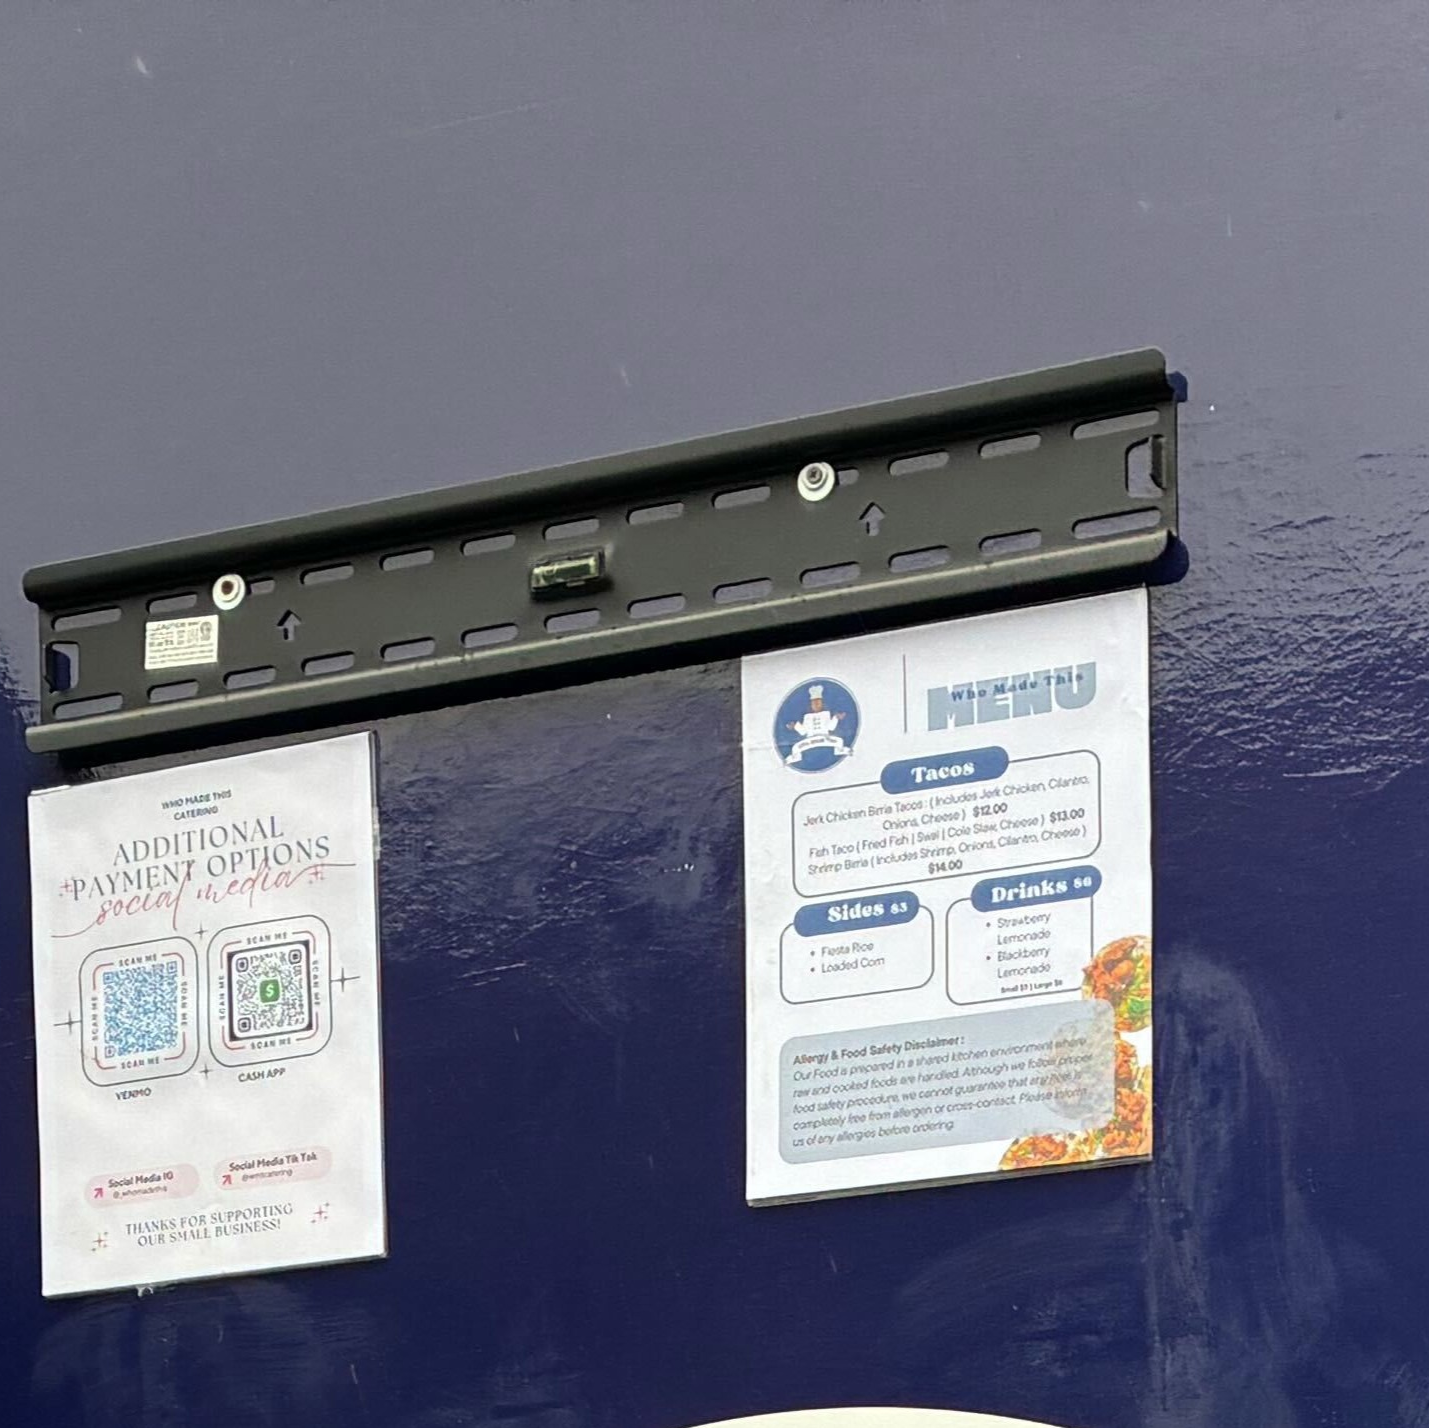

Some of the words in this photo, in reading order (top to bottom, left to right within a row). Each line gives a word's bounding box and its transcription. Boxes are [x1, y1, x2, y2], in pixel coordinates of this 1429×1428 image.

[951, 688, 986, 702] Who
[993, 680, 1038, 695] Made
[1044, 672, 1084, 686] This
[928, 661, 1096, 732] MENU
[911, 762, 975, 783] Tacos
[173, 805, 218, 820] CATERING
[803, 816, 824, 827] Jerk
[826, 810, 867, 823] Chicken
[895, 800, 923, 811] Tacos
[979, 787, 1000, 799] Jerk
[921, 812, 960, 825] Cheese
[973, 803, 1008, 818] $12.00
[113, 816, 284, 866] ADDITIONAL
[809, 846, 829, 858] Fish
[831, 844, 855, 855] Taco
[889, 835, 909, 847] Fish
[948, 826, 971, 838] Cole
[999, 817, 1039, 830] Cheese
[1049, 808, 1085, 823] $13.00
[808, 862, 843, 875] Shrimp
[1041, 828, 1080, 841] Cheese
[71, 859, 196, 900] PAYMENT
[207, 836, 329, 877] OPTIONS
[928, 859, 962, 875] $14.00
[83, 859, 196, 932] social
[197, 856, 306, 907] media
[991, 879, 1068, 903] Drinks
[827, 902, 884, 922] Sides
[997, 912, 1051, 928] Strawberry
[246, 934, 271, 945] SCAN
[275, 931, 288, 940] ME
[997, 928, 1051, 945] Lemonade
[821, 946, 849, 957] Fiesta
[852, 942, 874, 953] Rice
[997, 947, 1051, 962] Blackberry
[119, 956, 142, 967] SCAN
[145, 953, 157, 962] ME
[821, 960, 858, 973] Loaded
[860, 956, 885, 969] Corn
[997, 962, 1051, 979] Lemonade
[219, 976, 225, 990] ME
[91, 996, 98, 1011] ME
[314, 992, 321, 1006] ME
[91, 1013, 99, 1041] SCAN
[181, 1013, 188, 1026] ME
[250, 1039, 275, 1050] SCAN
[279, 1037, 292, 1046] ME
[793, 1052, 828, 1066] Allergy
[841, 1047, 867, 1059] Food
[870, 1042, 902, 1056] Safety
[793, 1071, 812, 1082] Our
[813, 1067, 839, 1080] Food
[850, 1060, 895, 1075] prepared
[916, 1053, 949, 1066] shared
[951, 1049, 988, 1062] kitchen
[990, 1040, 1053, 1057] environment
[121, 1060, 144, 1070] SCAN
[147, 1057, 160, 1066] ME
[238, 1070, 264, 1082] CASH
[266, 1068, 286, 1078] APP
[115, 1087, 152, 1100] VENMO
[811, 1085, 831, 1096] and
[832, 1080, 869, 1093] cooked
[919, 1086, 954, 1099] cannot
[878, 1124, 911, 1137] before
[229, 1160, 255, 1171] Social
[257, 1157, 284, 1167] Media
[285, 1154, 299, 1164] Tik
[108, 1176, 133, 1188] Social
[135, 1173, 161, 1184] Media
[125, 1217, 176, 1235] THANKS
[180, 1212, 206, 1228] FOR
[210, 1203, 293, 1225] SUPPORTING
[137, 1232, 165, 1247] OUR
[169, 1227, 211, 1243] SMALL
[215, 1219, 281, 1238] BUSINESS!
